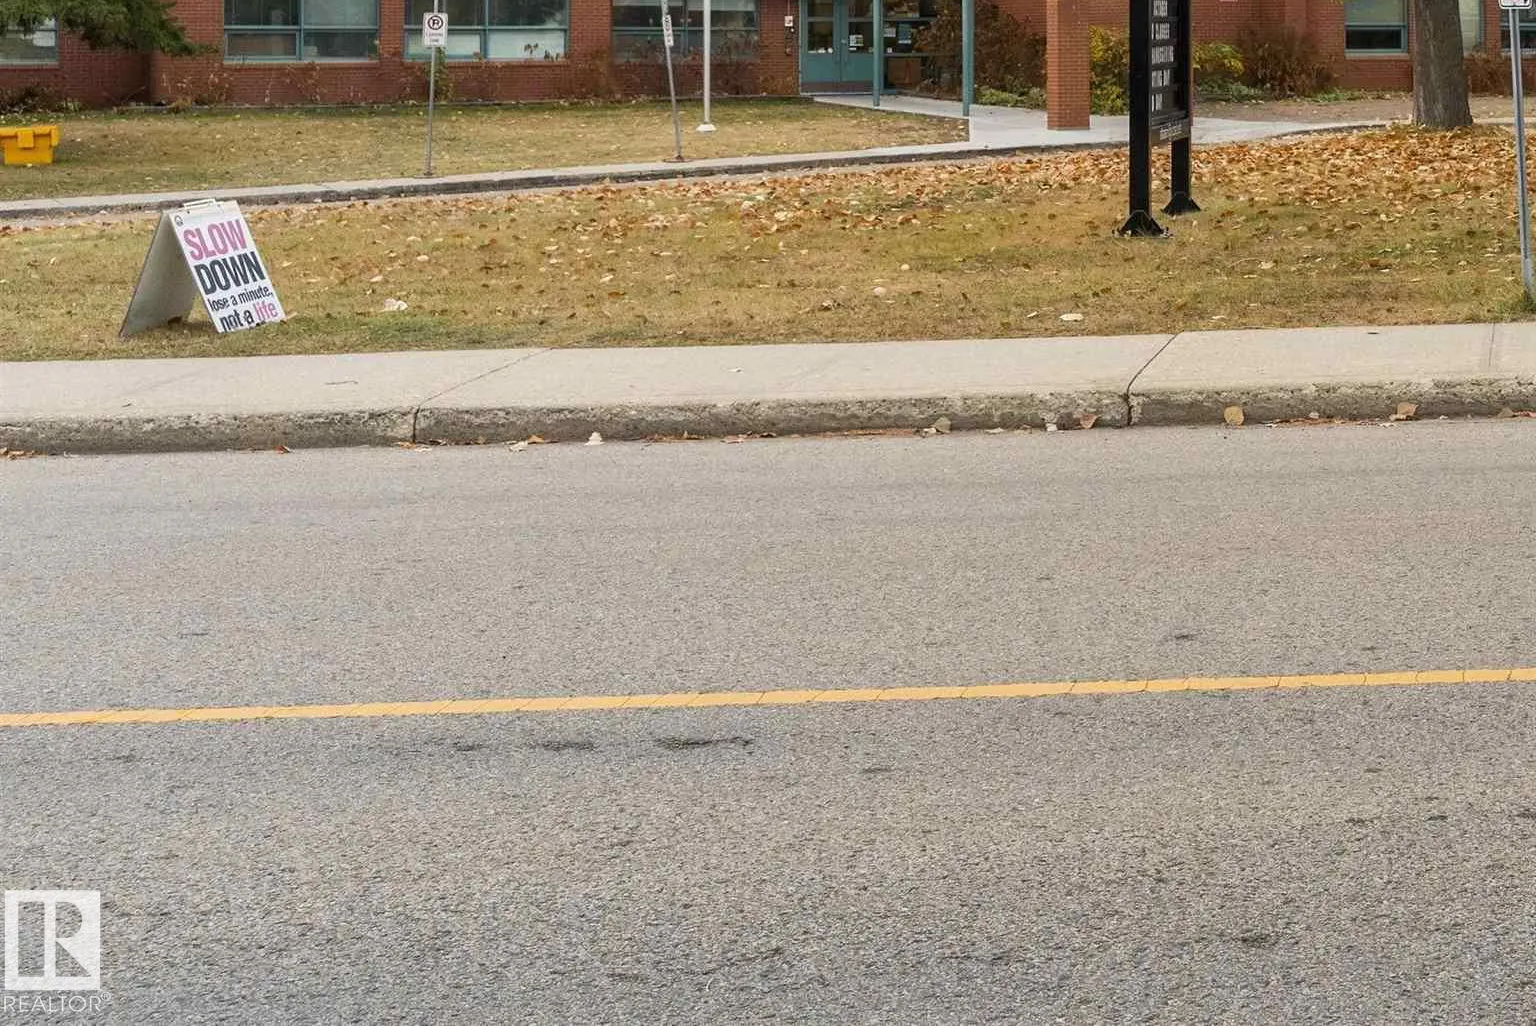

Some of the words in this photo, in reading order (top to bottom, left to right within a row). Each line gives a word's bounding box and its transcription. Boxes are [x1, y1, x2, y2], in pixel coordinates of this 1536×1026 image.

[183, 219, 247, 262] SLOW
[194, 251, 266, 295] DOWN
[207, 297, 230, 312] lose
[230, 295, 238, 306] a
[220, 309, 244, 333] not
[244, 310, 254, 325] a
[253, 301, 278, 321] life
